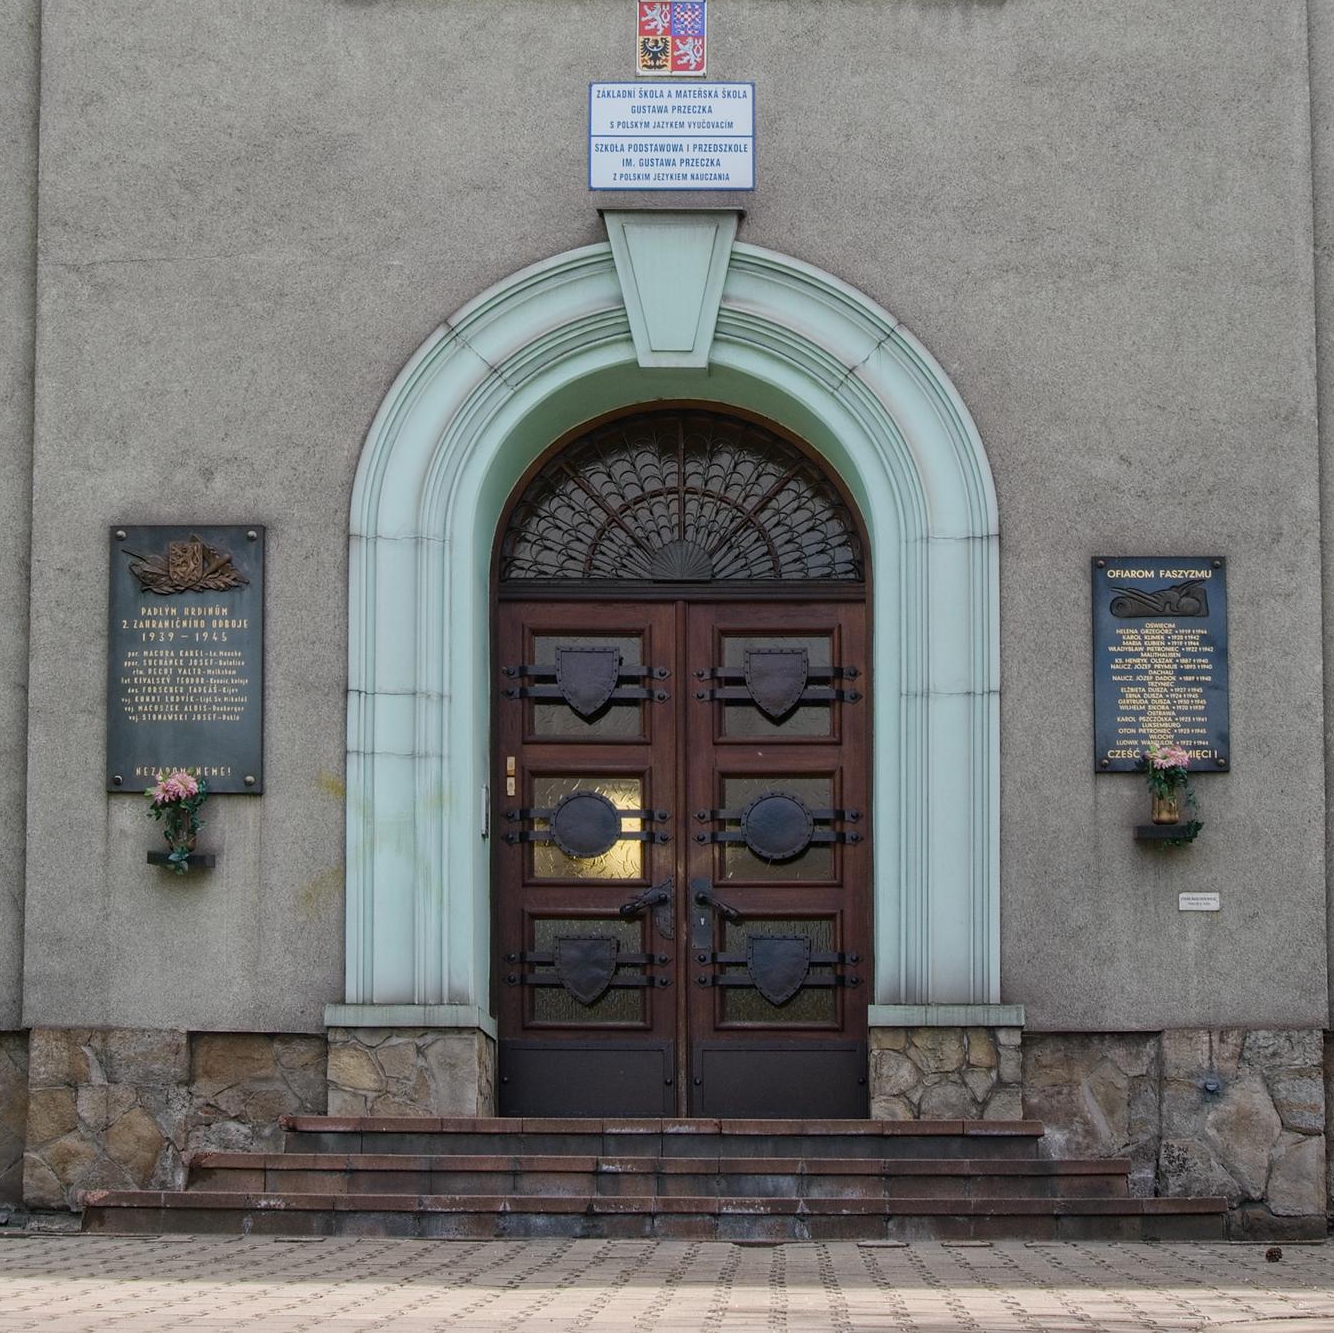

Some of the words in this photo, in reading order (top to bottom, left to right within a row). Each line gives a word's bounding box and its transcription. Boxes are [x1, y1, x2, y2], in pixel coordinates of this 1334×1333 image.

[596, 88, 636, 99] ZÁKLADNÍ
[638, 88, 664, 99] ŠKOLA
[667, 90, 672, 99] A
[722, 88, 748, 99] ŠKOLA
[630, 105, 668, 114] GUSTAWA
[672, 105, 712, 114] PRZECZKA
[610, 121, 614, 129] S
[617, 120, 650, 129] POLSKÝM
[652, 121, 684, 129] JAZYKEM
[688, 120, 734, 129] VYUČOVACÍM
[594, 144, 625, 152] SZKOŁA
[628, 144, 684, 152] PODSTAWOWA
[686, 144, 690, 152] I
[692, 144, 748, 152] PRZEDSZKOLE
[622, 158, 636, 167] IM.
[638, 158, 676, 167] GUSTAWA
[680, 158, 720, 167] PRZECZKA
[613, 173, 617, 181] Z
[620, 173, 650, 181] POLSKIM
[653, 173, 688, 181] JĘZYKIEM
[690, 173, 730, 181] NAUCZANIA
[1107, 570, 1154, 578] OFIAROM
[1160, 570, 1212, 578] FASZYZMU
[184, 604, 228, 616] HRDINŮM
[122, 620, 129, 628] 2.
[133, 618, 206, 628] ZAHRANIČNÍHO
[212, 620, 248, 628] ODBOJE
[142, 632, 174, 642] 1939
[195, 632, 228, 642] 1945
[1108, 748, 1140, 758] CZEŚĆ
